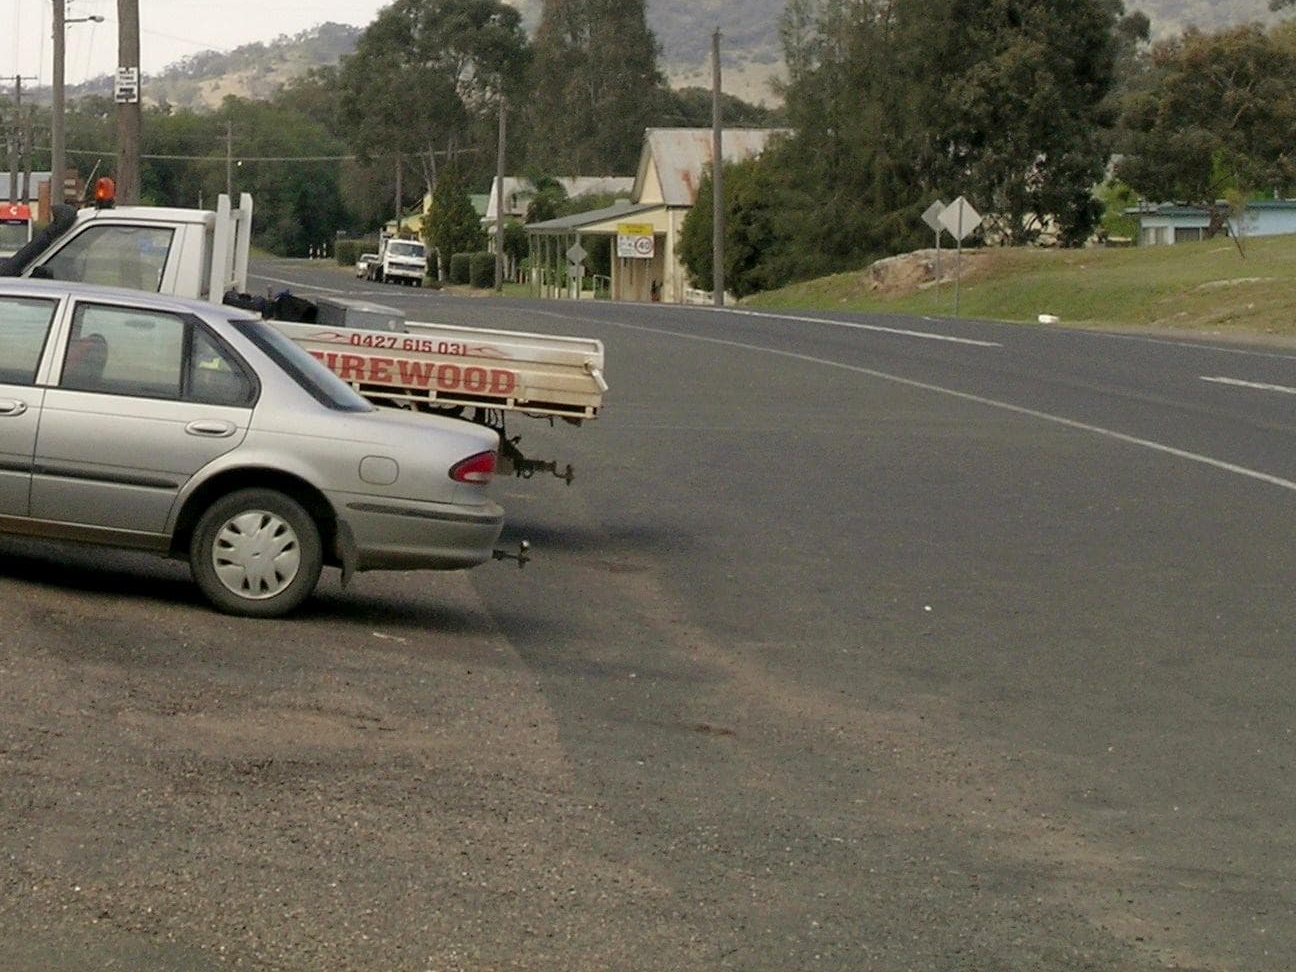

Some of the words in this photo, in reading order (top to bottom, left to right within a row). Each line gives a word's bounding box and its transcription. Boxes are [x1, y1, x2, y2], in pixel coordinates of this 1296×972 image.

[639, 241, 650, 250] 40
[350, 333, 398, 349] 0427
[403, 340, 432, 353] 615
[438, 342, 467, 356] 031
[308, 351, 516, 395] IREWOOD
